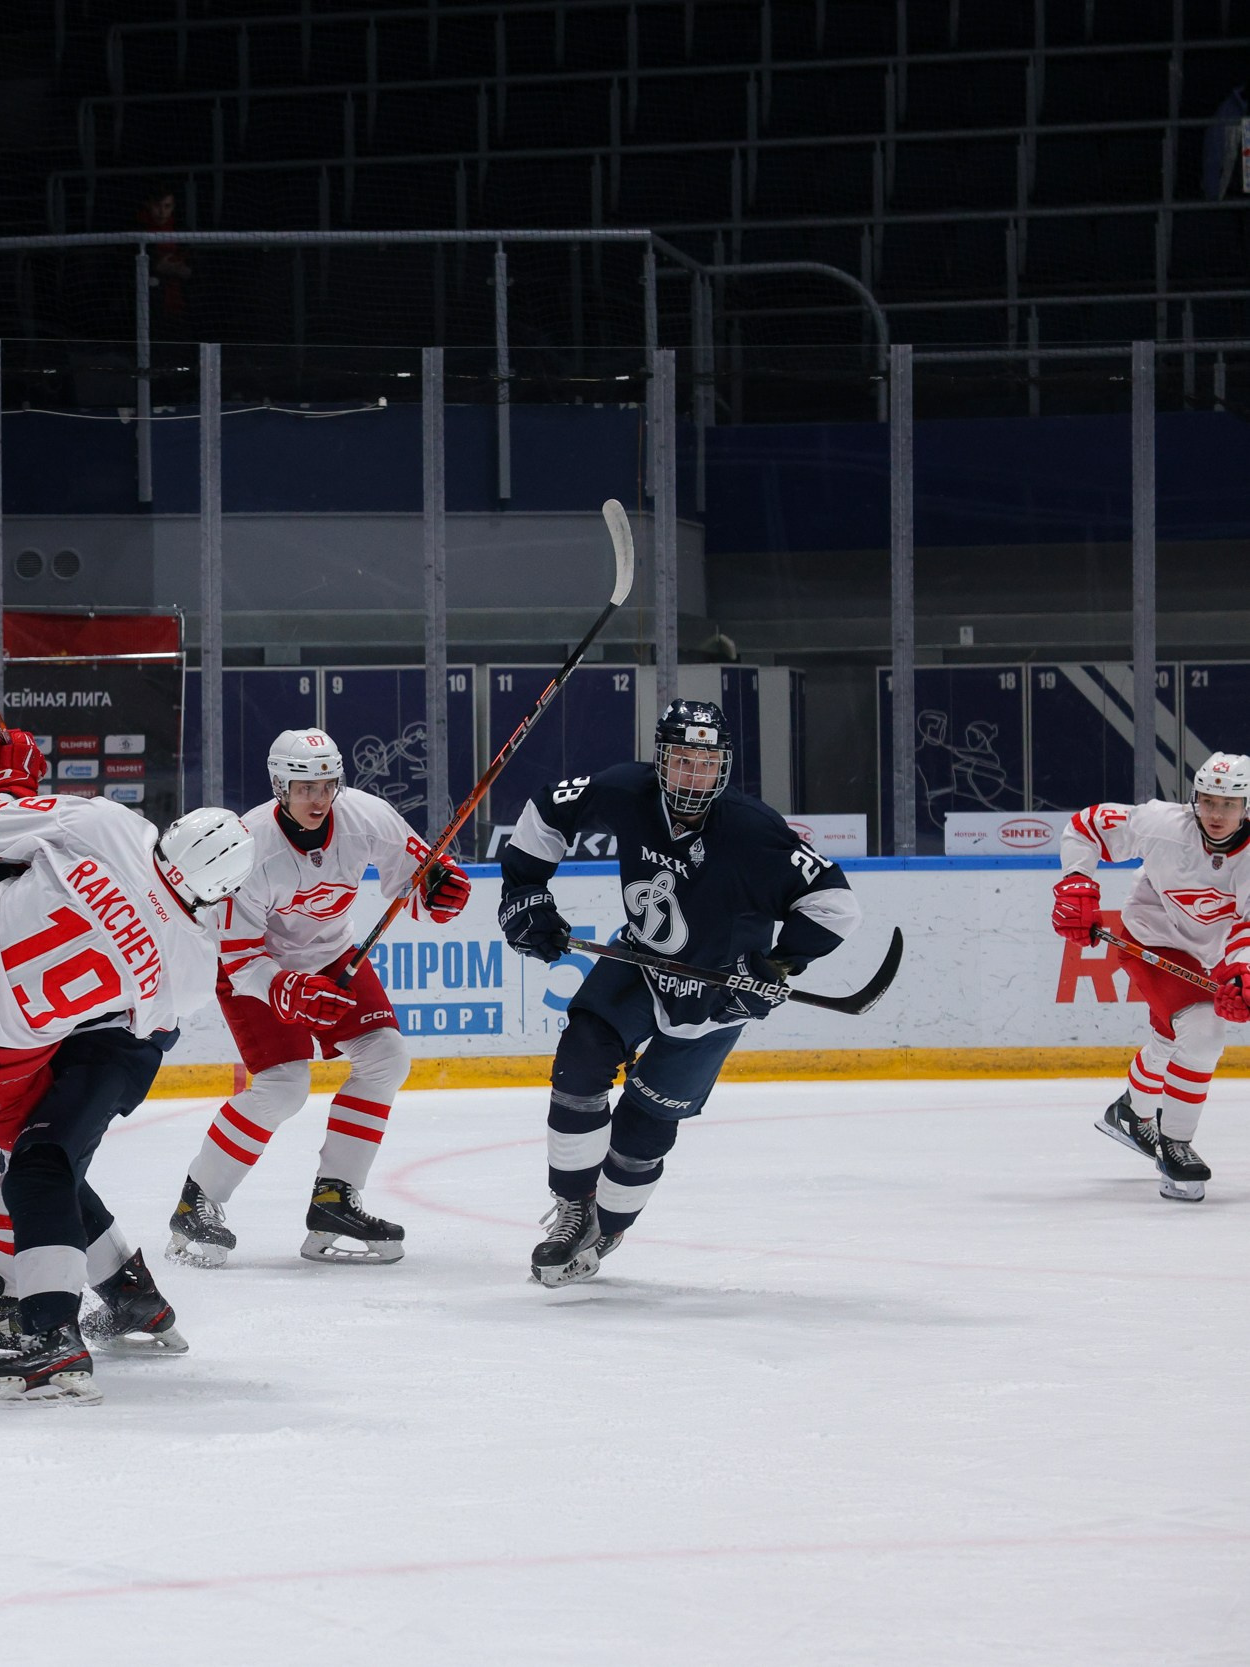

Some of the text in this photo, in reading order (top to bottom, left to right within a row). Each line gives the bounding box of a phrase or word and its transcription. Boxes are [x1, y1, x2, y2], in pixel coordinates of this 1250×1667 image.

[299, 676, 310, 695] 8
[332, 676, 343, 695] 9
[448, 674, 466, 692] 10
[498, 674, 512, 691] 11
[613, 674, 630, 691] 12
[999, 673, 1016, 690] 18
[1038, 672, 1055, 689] 19
[1191, 670, 1209, 687] 21
[69, 692, 112, 707] ЛИГА
[693, 711, 712, 723] 28
[305, 735, 326, 747] 87
[107, 765, 143, 773] OLIMPBET
[1213, 761, 1231, 772] 24
[1001, 827, 1050, 839] SINTEC
[406, 836, 432, 862] 8
[641, 845, 690, 880] МХК
[166, 864, 184, 886] 19
[216, 896, 234, 930] 7
[499, 892, 555, 926] BAUER
[1095, 929, 1128, 949] TRUE
[1, 906, 122, 1029] 19
[354, 940, 503, 990] ЗПРОМ
[1162, 960, 1219, 993] HZRDUS
[725, 974, 793, 1001] BAUER
[360, 1010, 394, 1024] CCM
[407, 1007, 497, 1031] ПОРТ
[631, 1076, 692, 1110] BAUER
